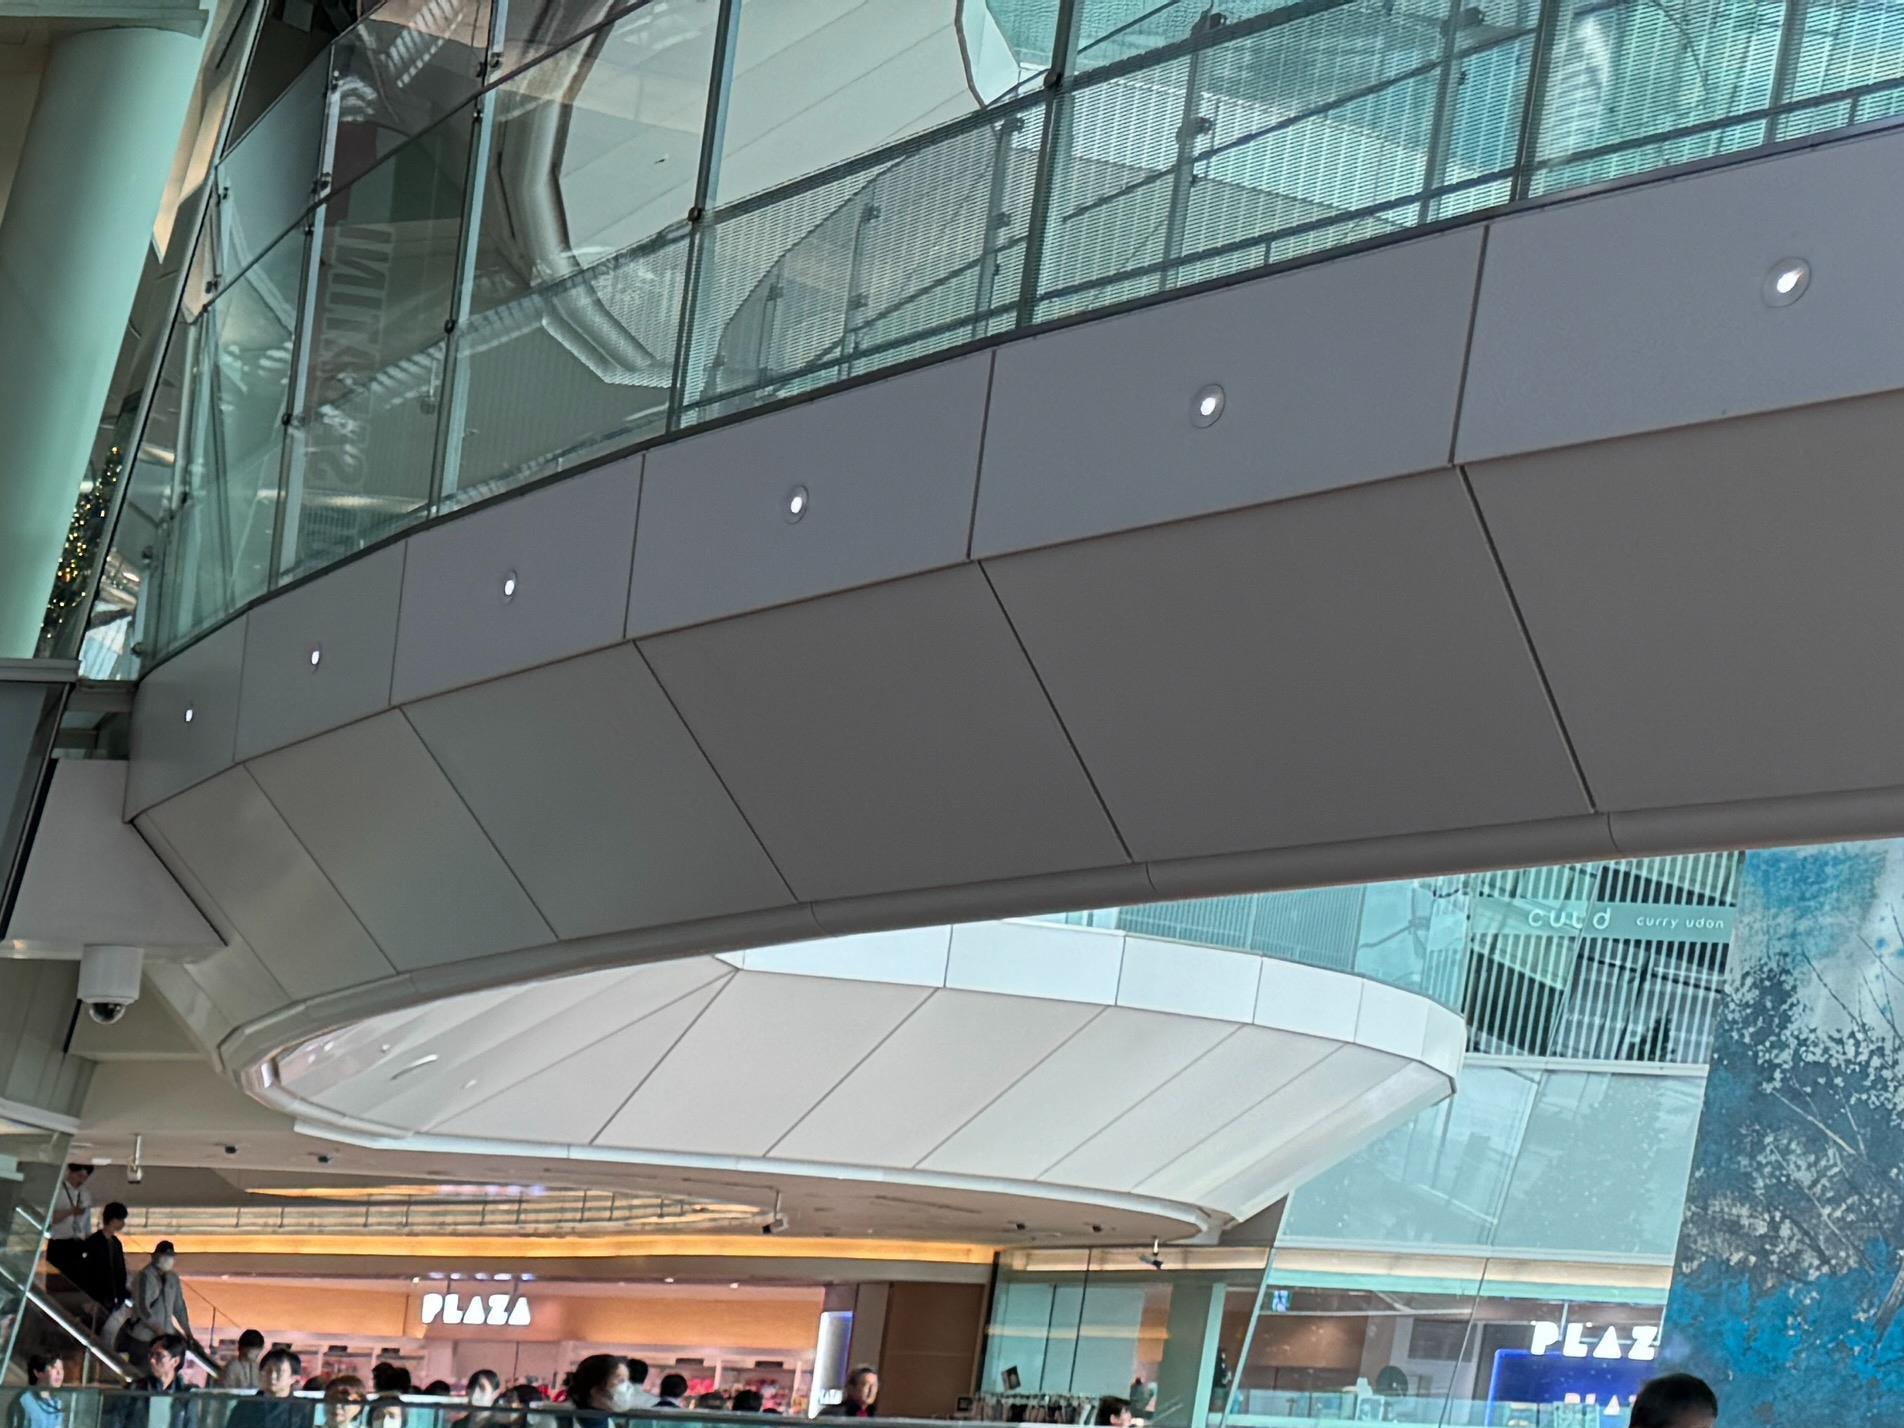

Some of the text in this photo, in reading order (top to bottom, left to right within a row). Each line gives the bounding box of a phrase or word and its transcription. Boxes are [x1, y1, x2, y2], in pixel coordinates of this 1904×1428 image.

[1636, 916, 1679, 929] curry
[1685, 916, 1724, 929] udon
[421, 1293, 531, 1326] PLAZA
[1530, 1320, 1658, 1361] PLAZ
